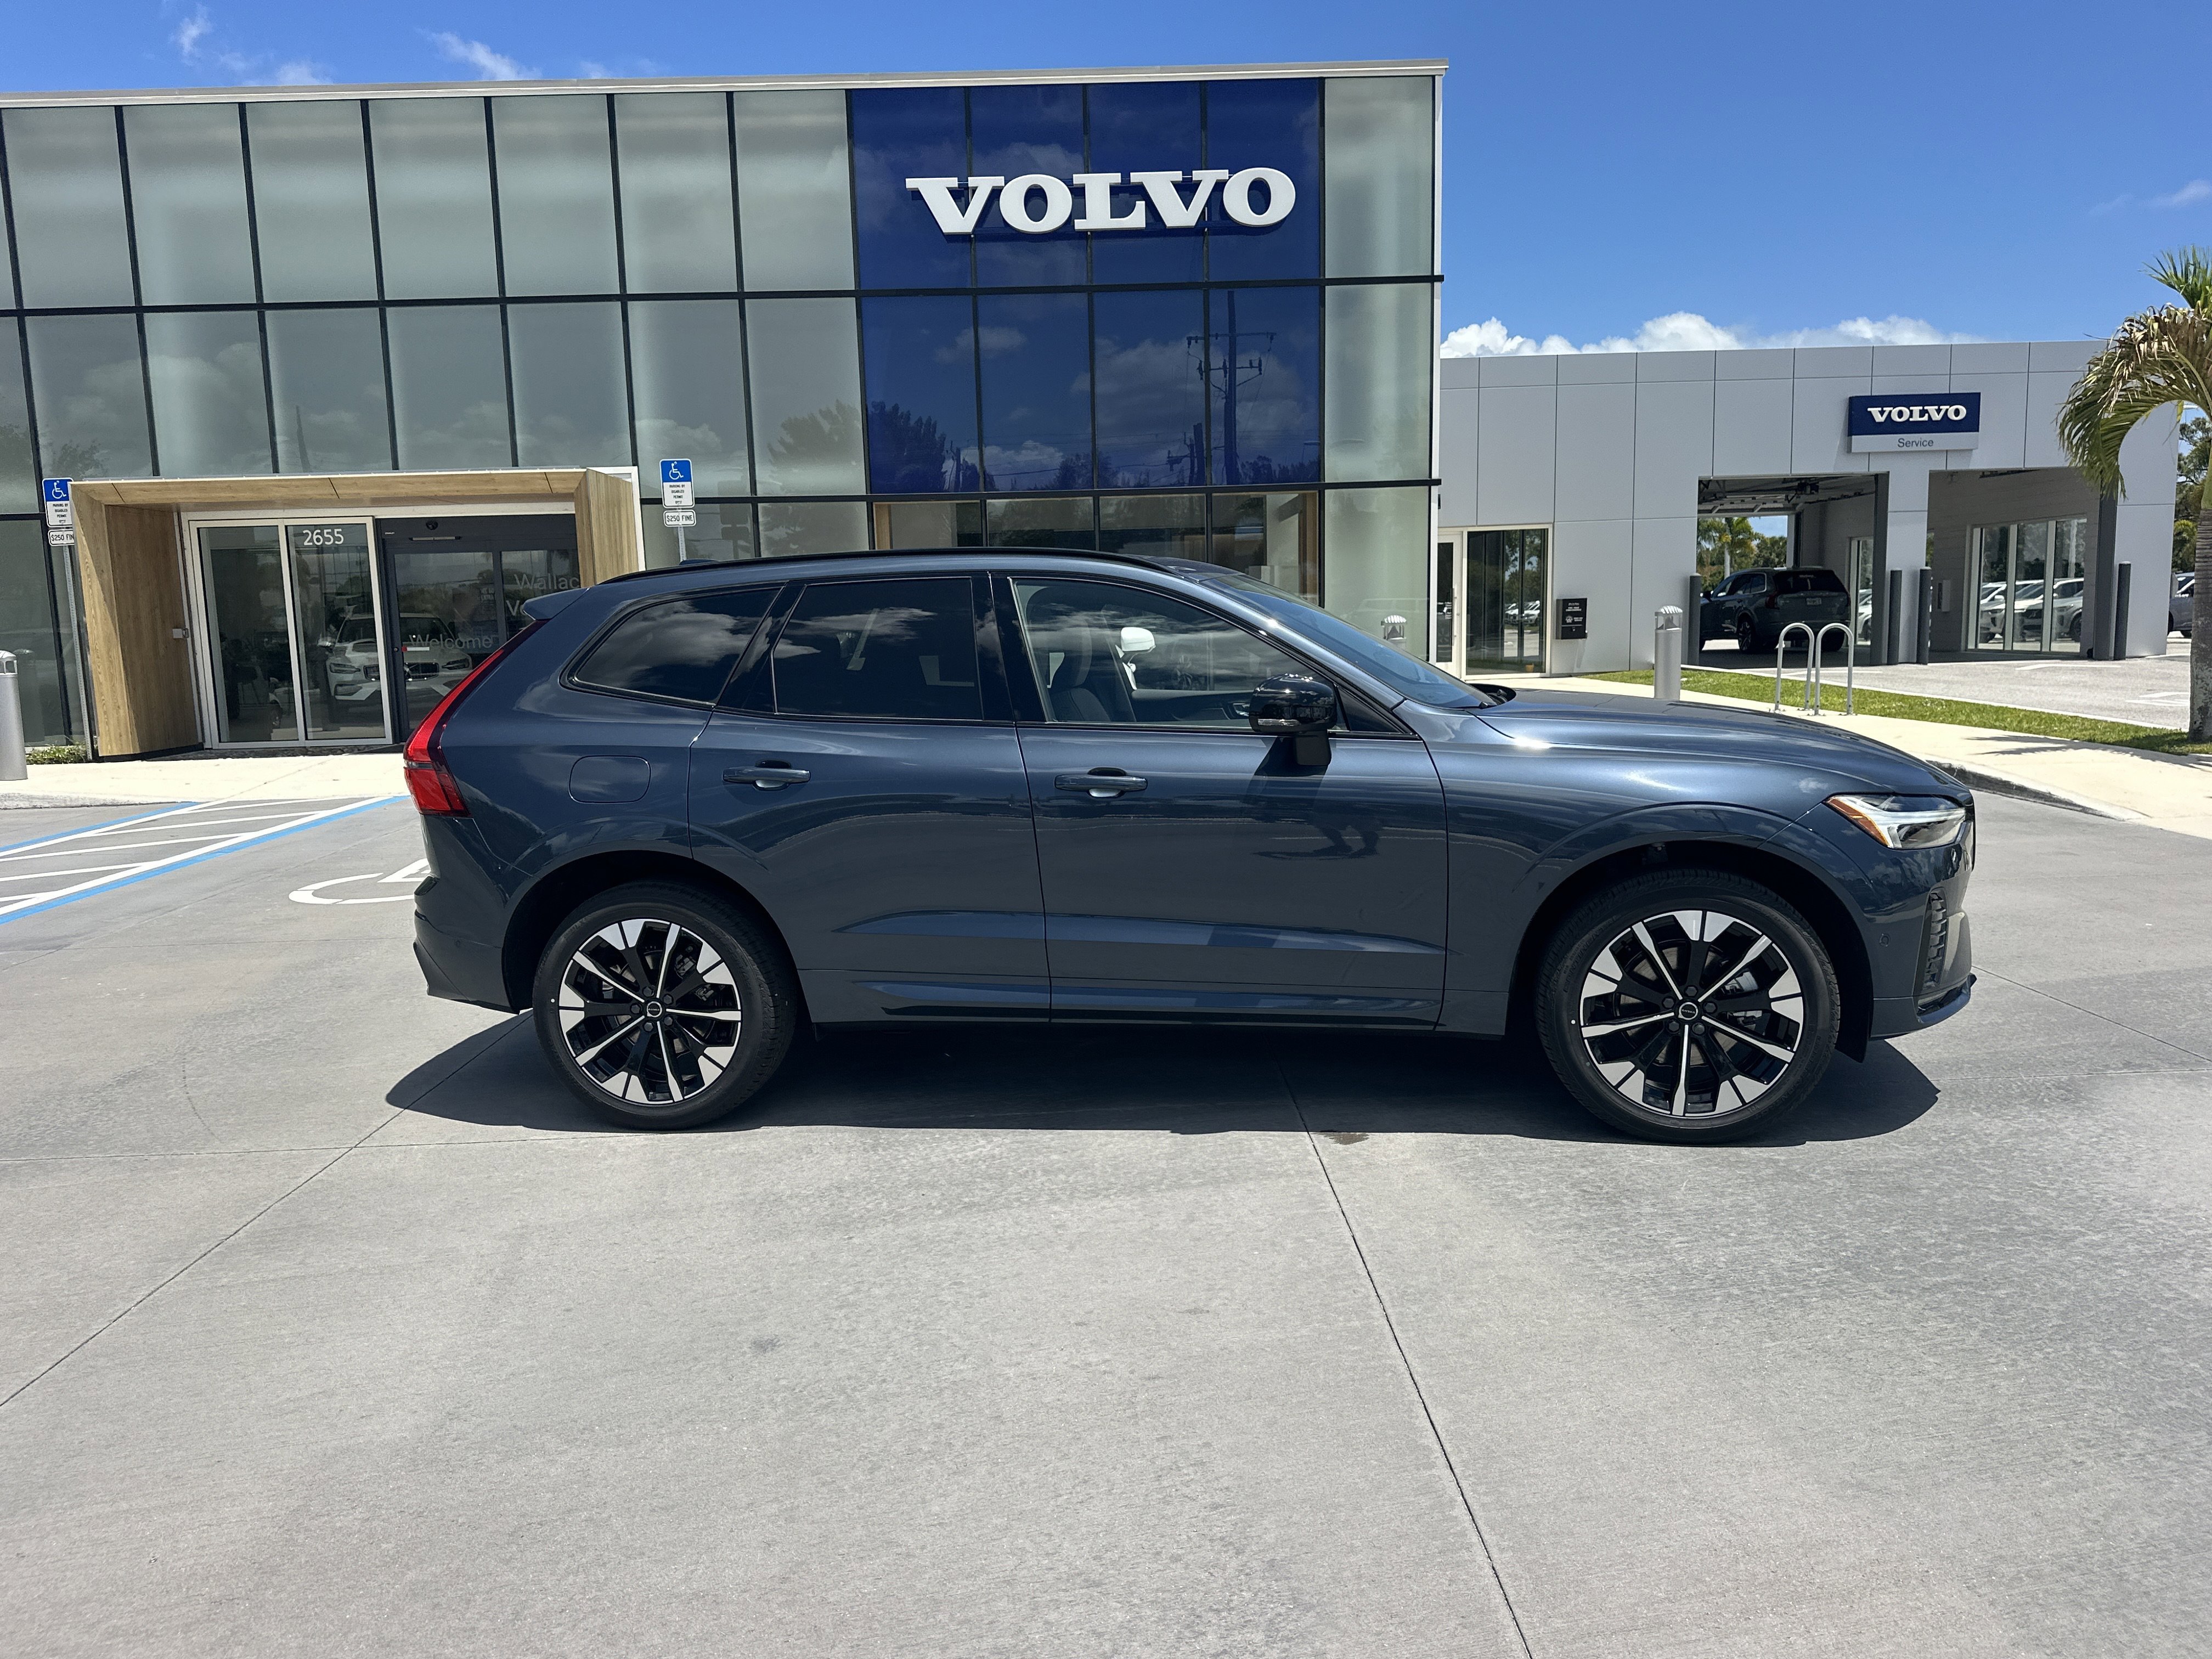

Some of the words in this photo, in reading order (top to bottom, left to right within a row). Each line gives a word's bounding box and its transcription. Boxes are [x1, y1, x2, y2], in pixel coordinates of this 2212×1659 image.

[906, 167, 1296, 235] VOLVO
[1867, 405, 1967, 422] VOLVO
[1897, 438, 1934, 448] Service
[303, 528, 343, 545] 2655
[514, 573, 580, 589] Wallac
[409, 634, 492, 649] Welcome
